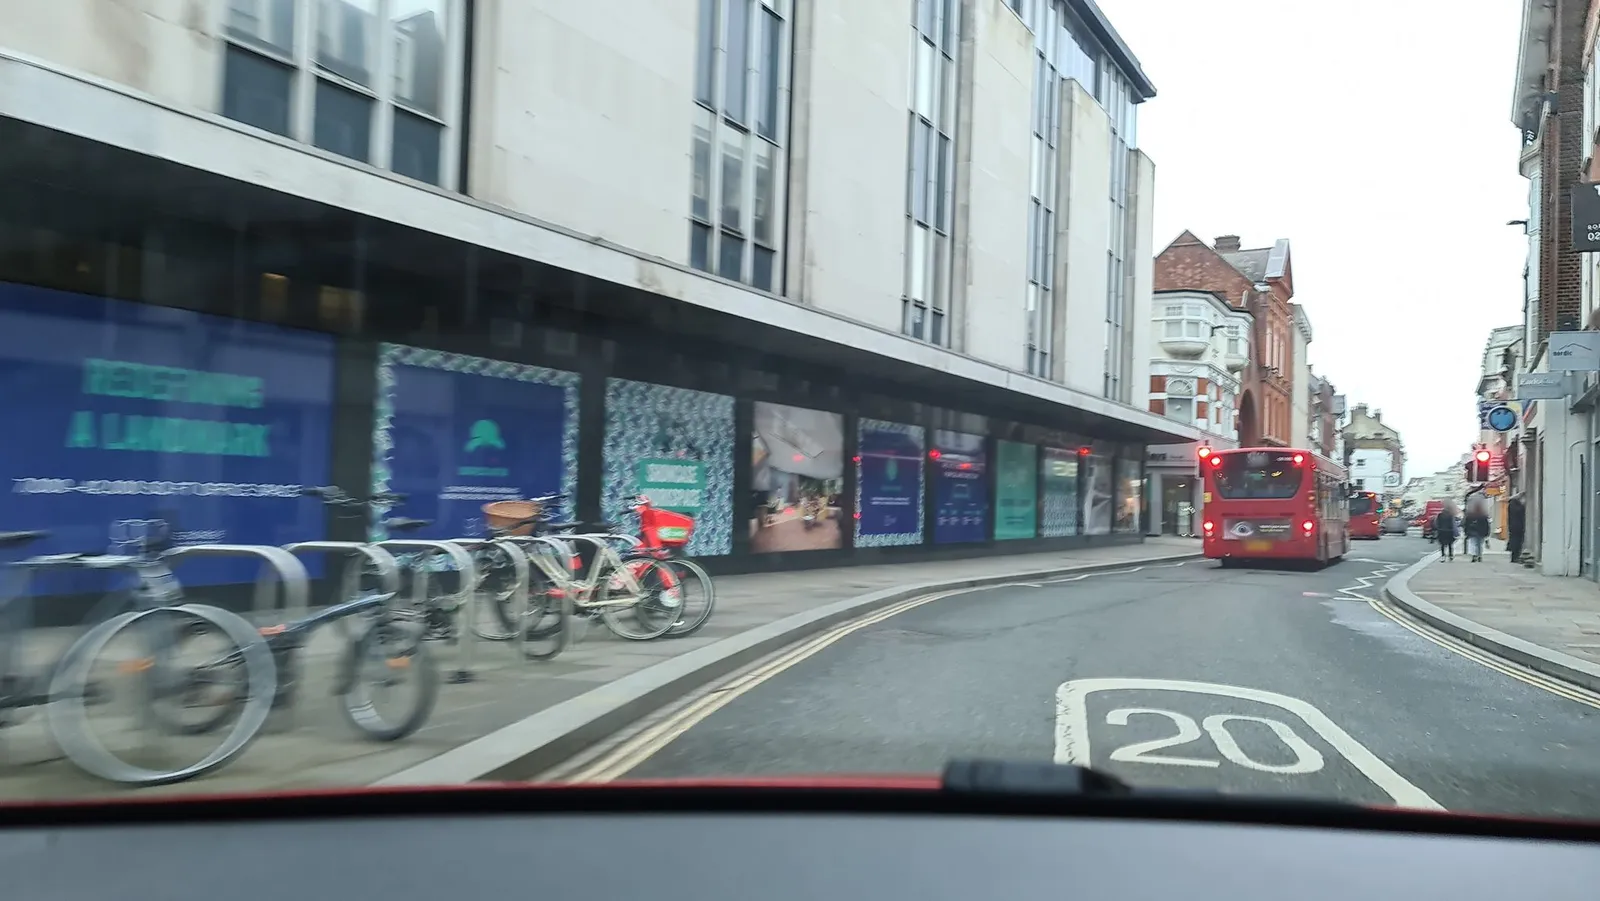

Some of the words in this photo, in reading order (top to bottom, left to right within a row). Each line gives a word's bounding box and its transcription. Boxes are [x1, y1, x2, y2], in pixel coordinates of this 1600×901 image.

[65, 410, 97, 448] A
[101, 413, 271, 457] LANDMARK
[1106, 707, 1325, 773] 20
